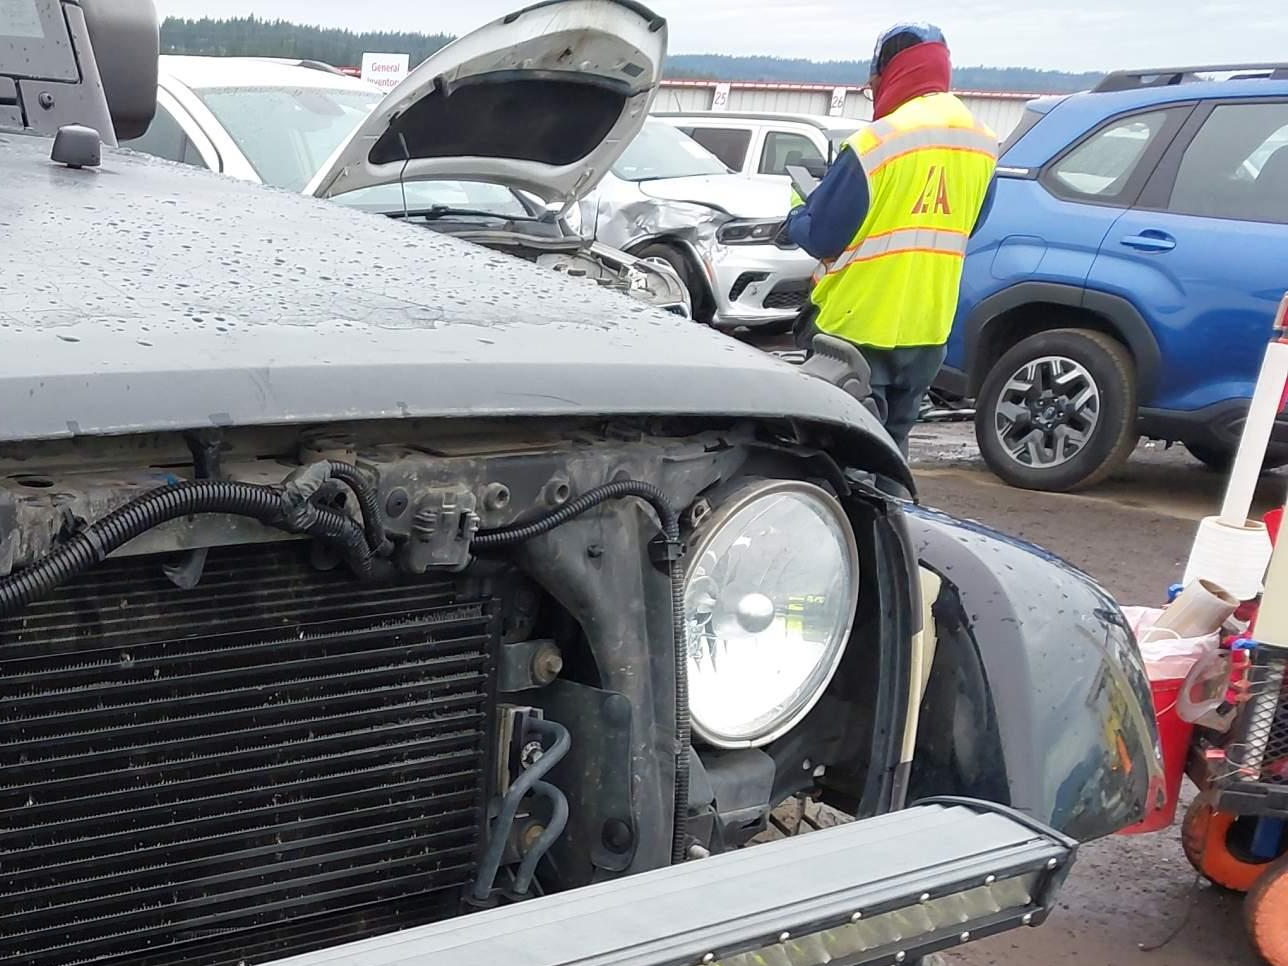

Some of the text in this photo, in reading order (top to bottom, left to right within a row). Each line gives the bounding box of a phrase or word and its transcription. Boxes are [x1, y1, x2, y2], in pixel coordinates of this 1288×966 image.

[372, 62, 400, 73] General
[367, 77, 400, 87] Inventor
[714, 91, 727, 106] 25
[831, 96, 844, 108] 26
